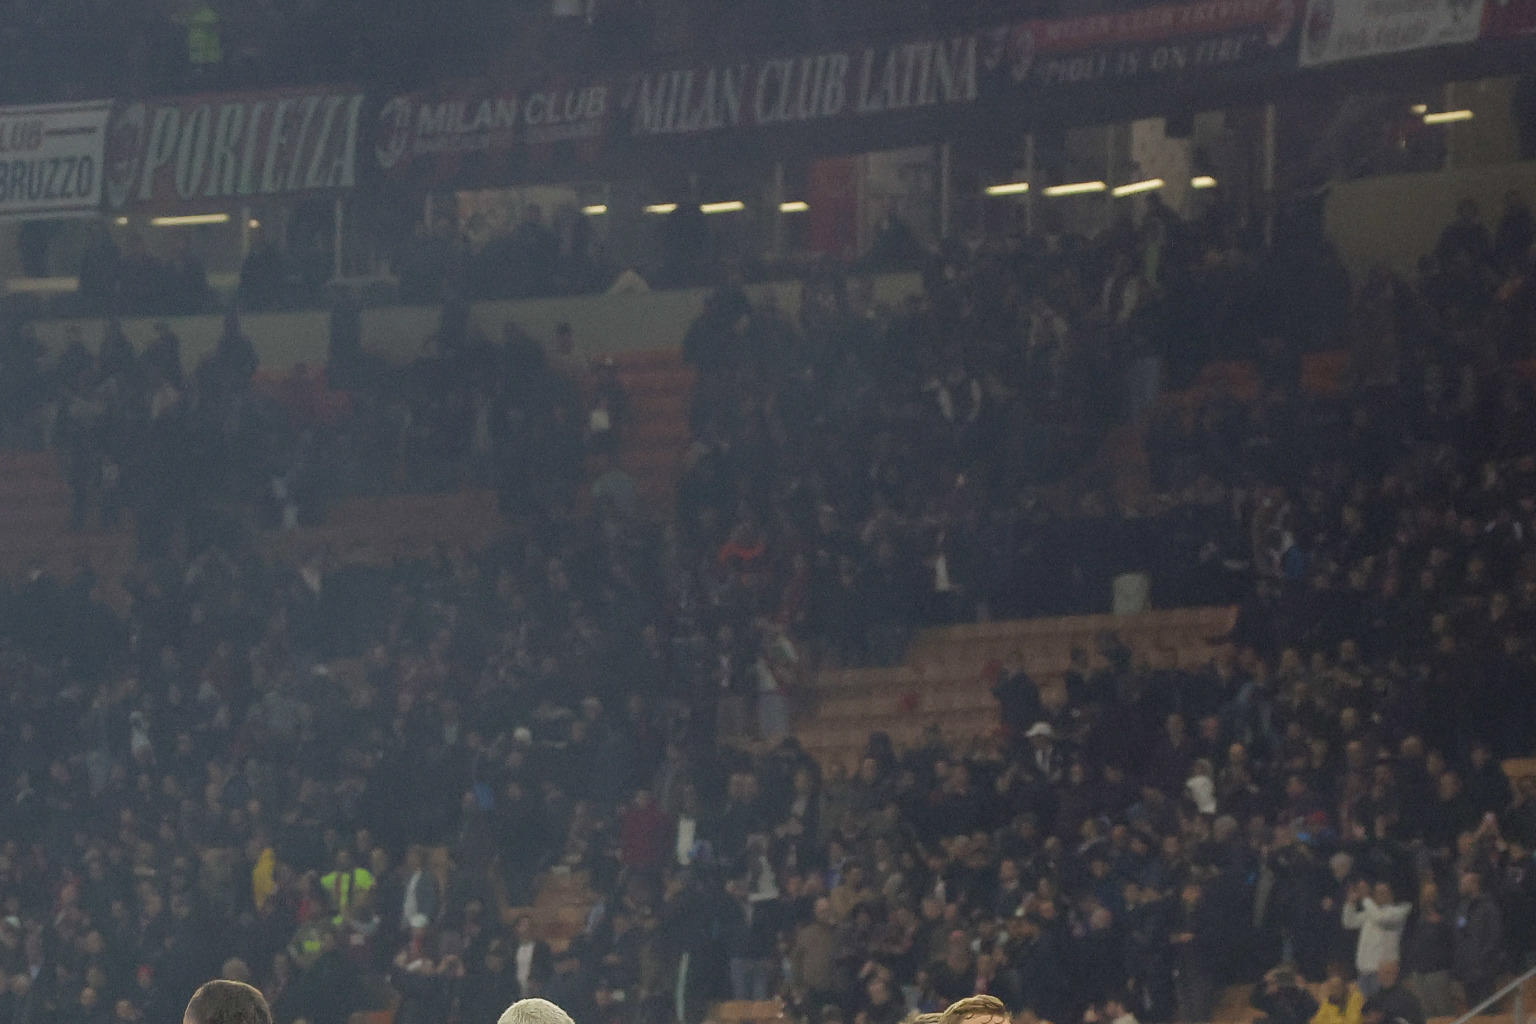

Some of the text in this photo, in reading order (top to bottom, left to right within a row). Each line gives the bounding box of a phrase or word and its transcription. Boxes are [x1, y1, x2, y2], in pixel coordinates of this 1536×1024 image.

[417, 86, 608, 134] MILAN CLUB
[755, 53, 851, 125] CLUB
